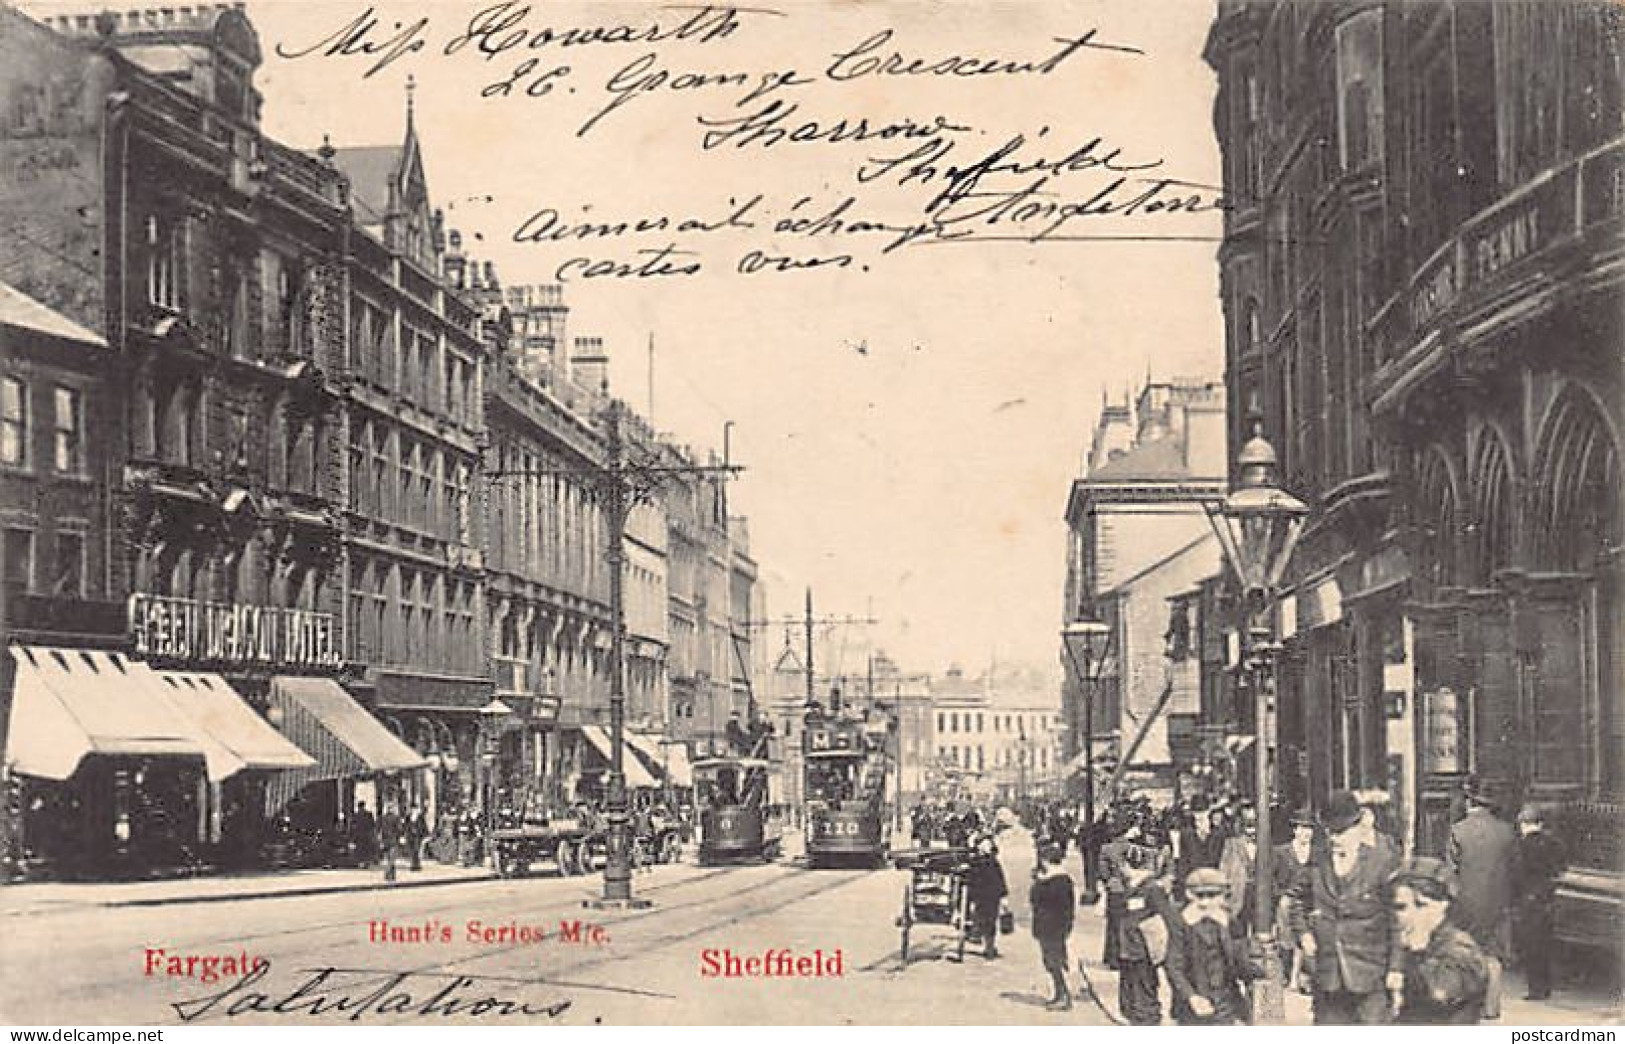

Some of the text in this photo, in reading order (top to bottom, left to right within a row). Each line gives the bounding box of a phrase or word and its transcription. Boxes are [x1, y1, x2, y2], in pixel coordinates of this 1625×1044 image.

[275, 0, 745, 79] Miss Howarth
[577, 52, 816, 137] Grange
[825, 28, 1145, 81] Crescent
[858, 126, 1162, 213] Sheffield
[555, 242, 702, 282] cartes
